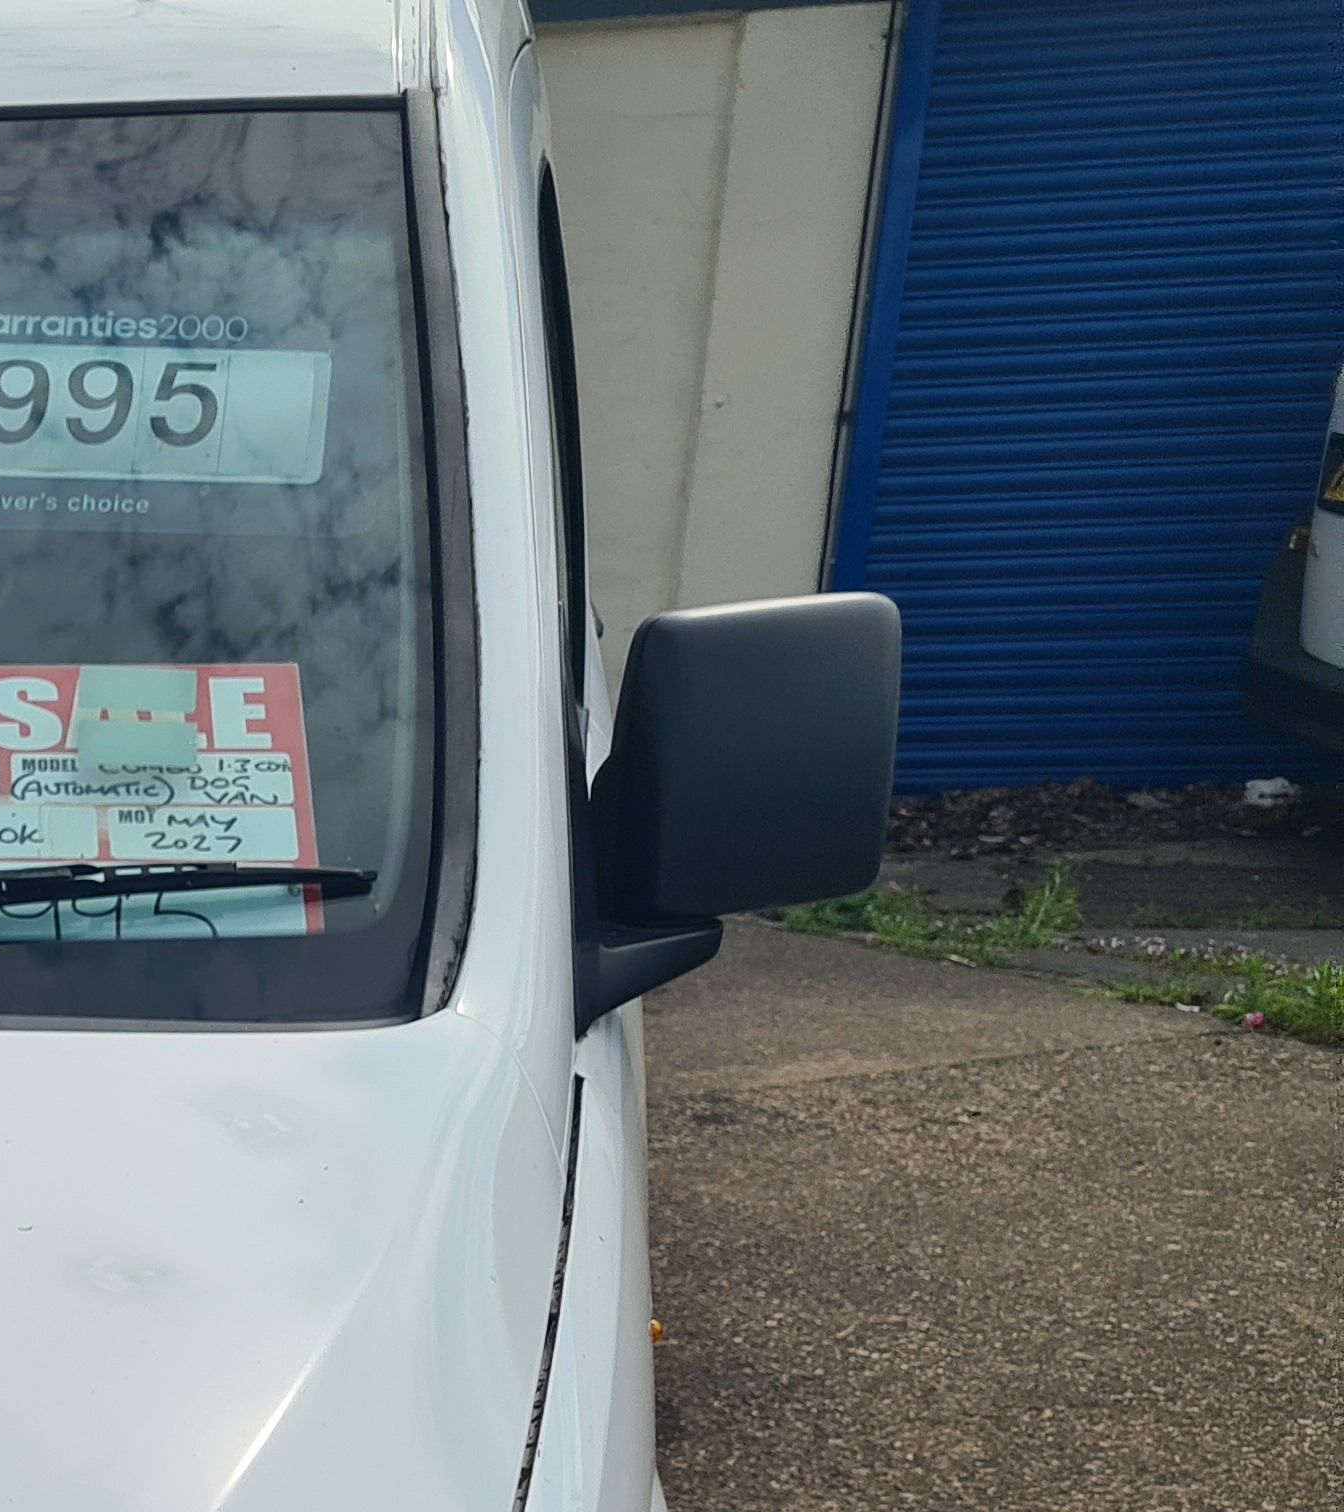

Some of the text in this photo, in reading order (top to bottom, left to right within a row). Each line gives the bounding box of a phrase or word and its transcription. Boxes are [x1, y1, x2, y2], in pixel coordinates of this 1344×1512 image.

[67, 494, 150, 514] choice
[21, 758, 80, 773] MODEL
[118, 808, 157, 824] MOT
[167, 812, 238, 832] MAY
[144, 831, 243, 853] 2027
